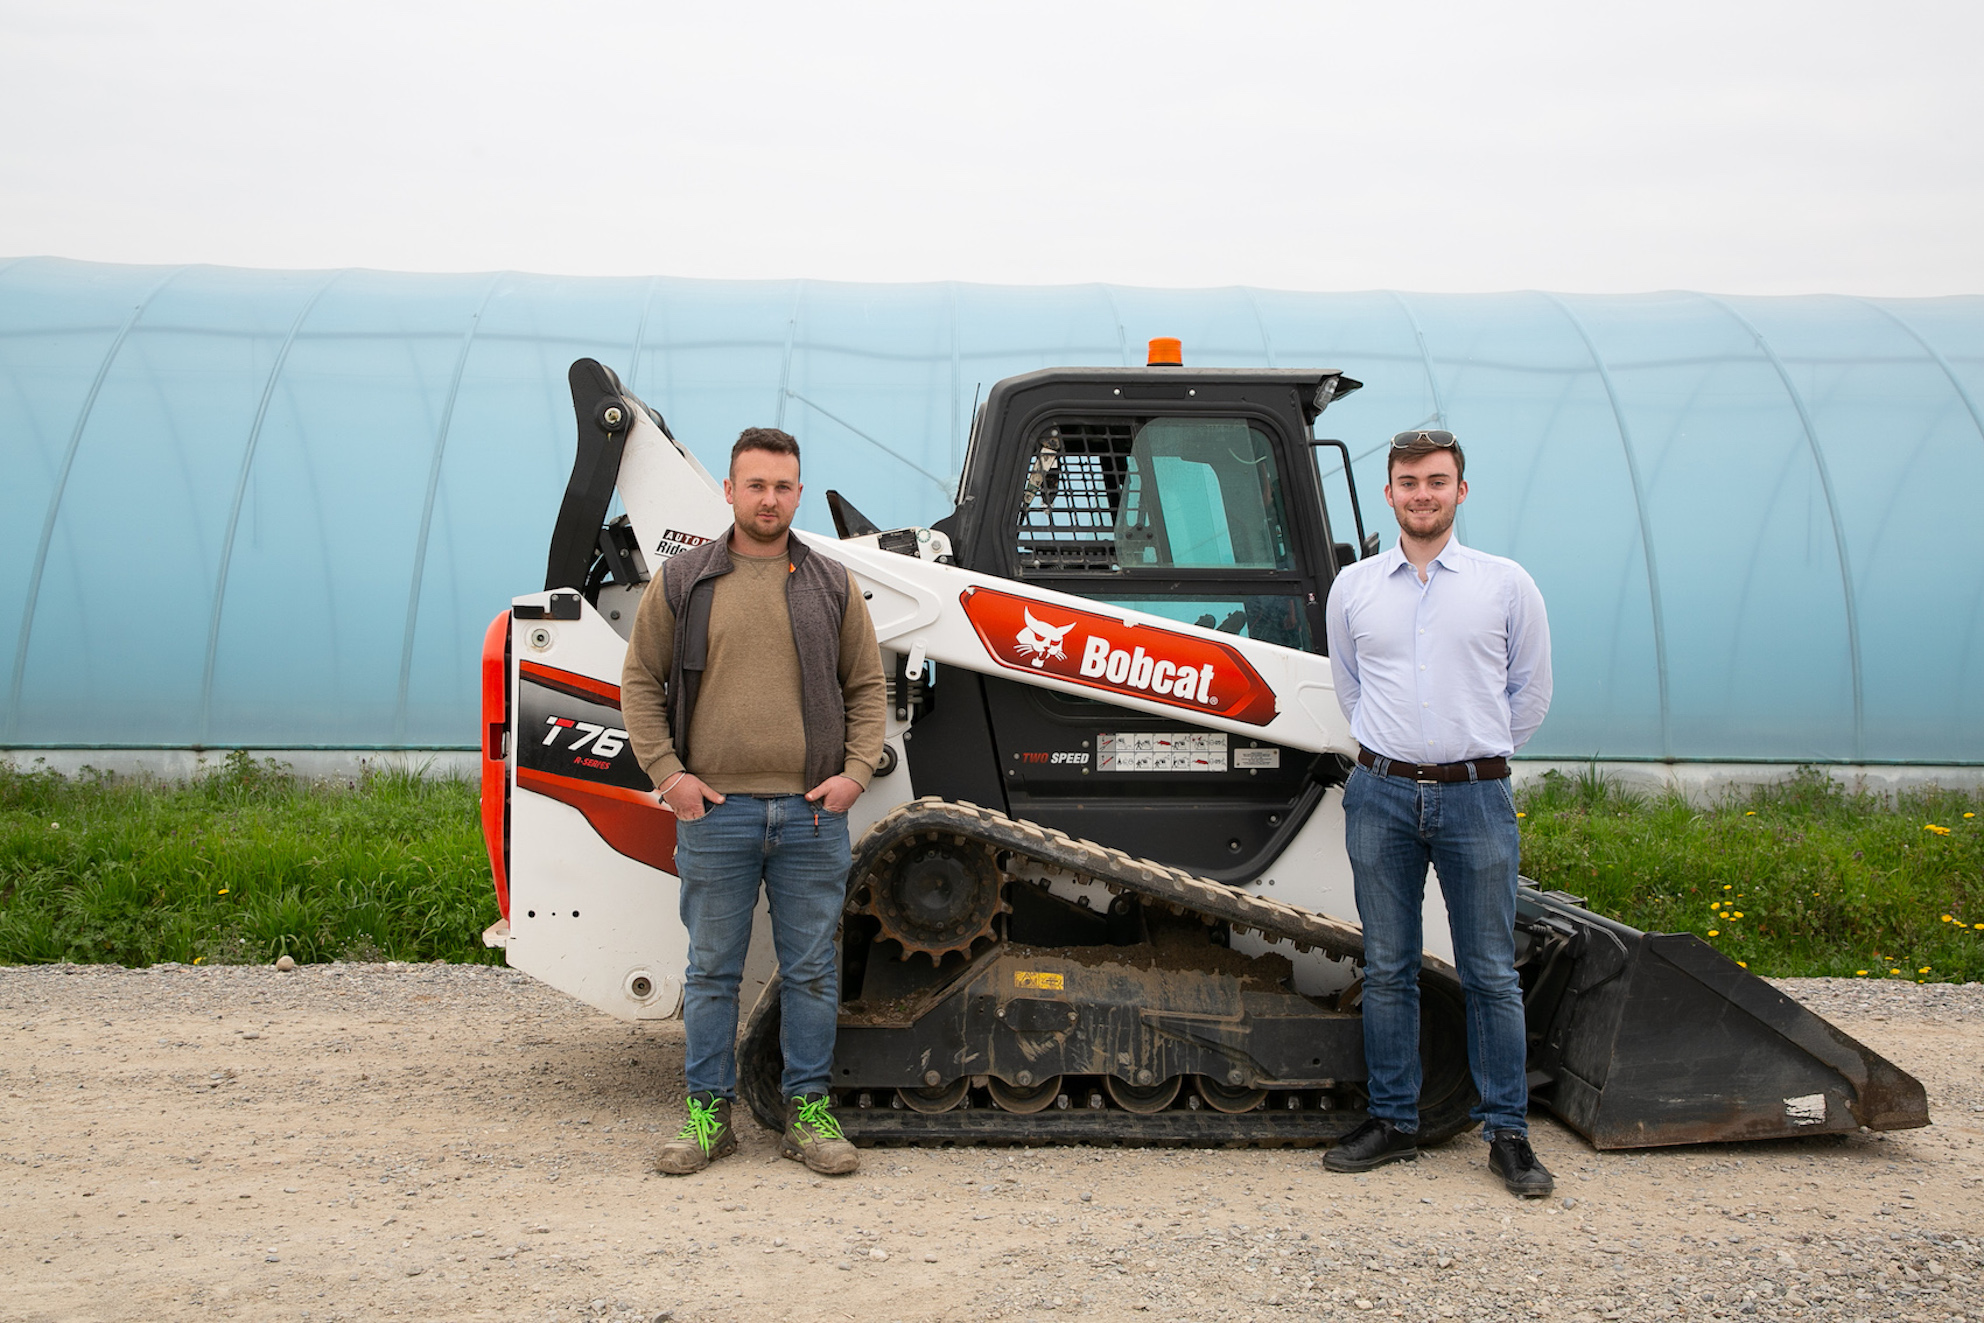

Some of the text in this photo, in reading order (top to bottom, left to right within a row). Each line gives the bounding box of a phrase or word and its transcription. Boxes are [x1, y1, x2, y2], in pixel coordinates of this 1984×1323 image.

[1079, 635, 1215, 704] Bobcat
[542, 716, 629, 758] T76
[573, 756, 611, 770] R-SERIES
[1022, 752, 1090, 764] TWO SPEED
